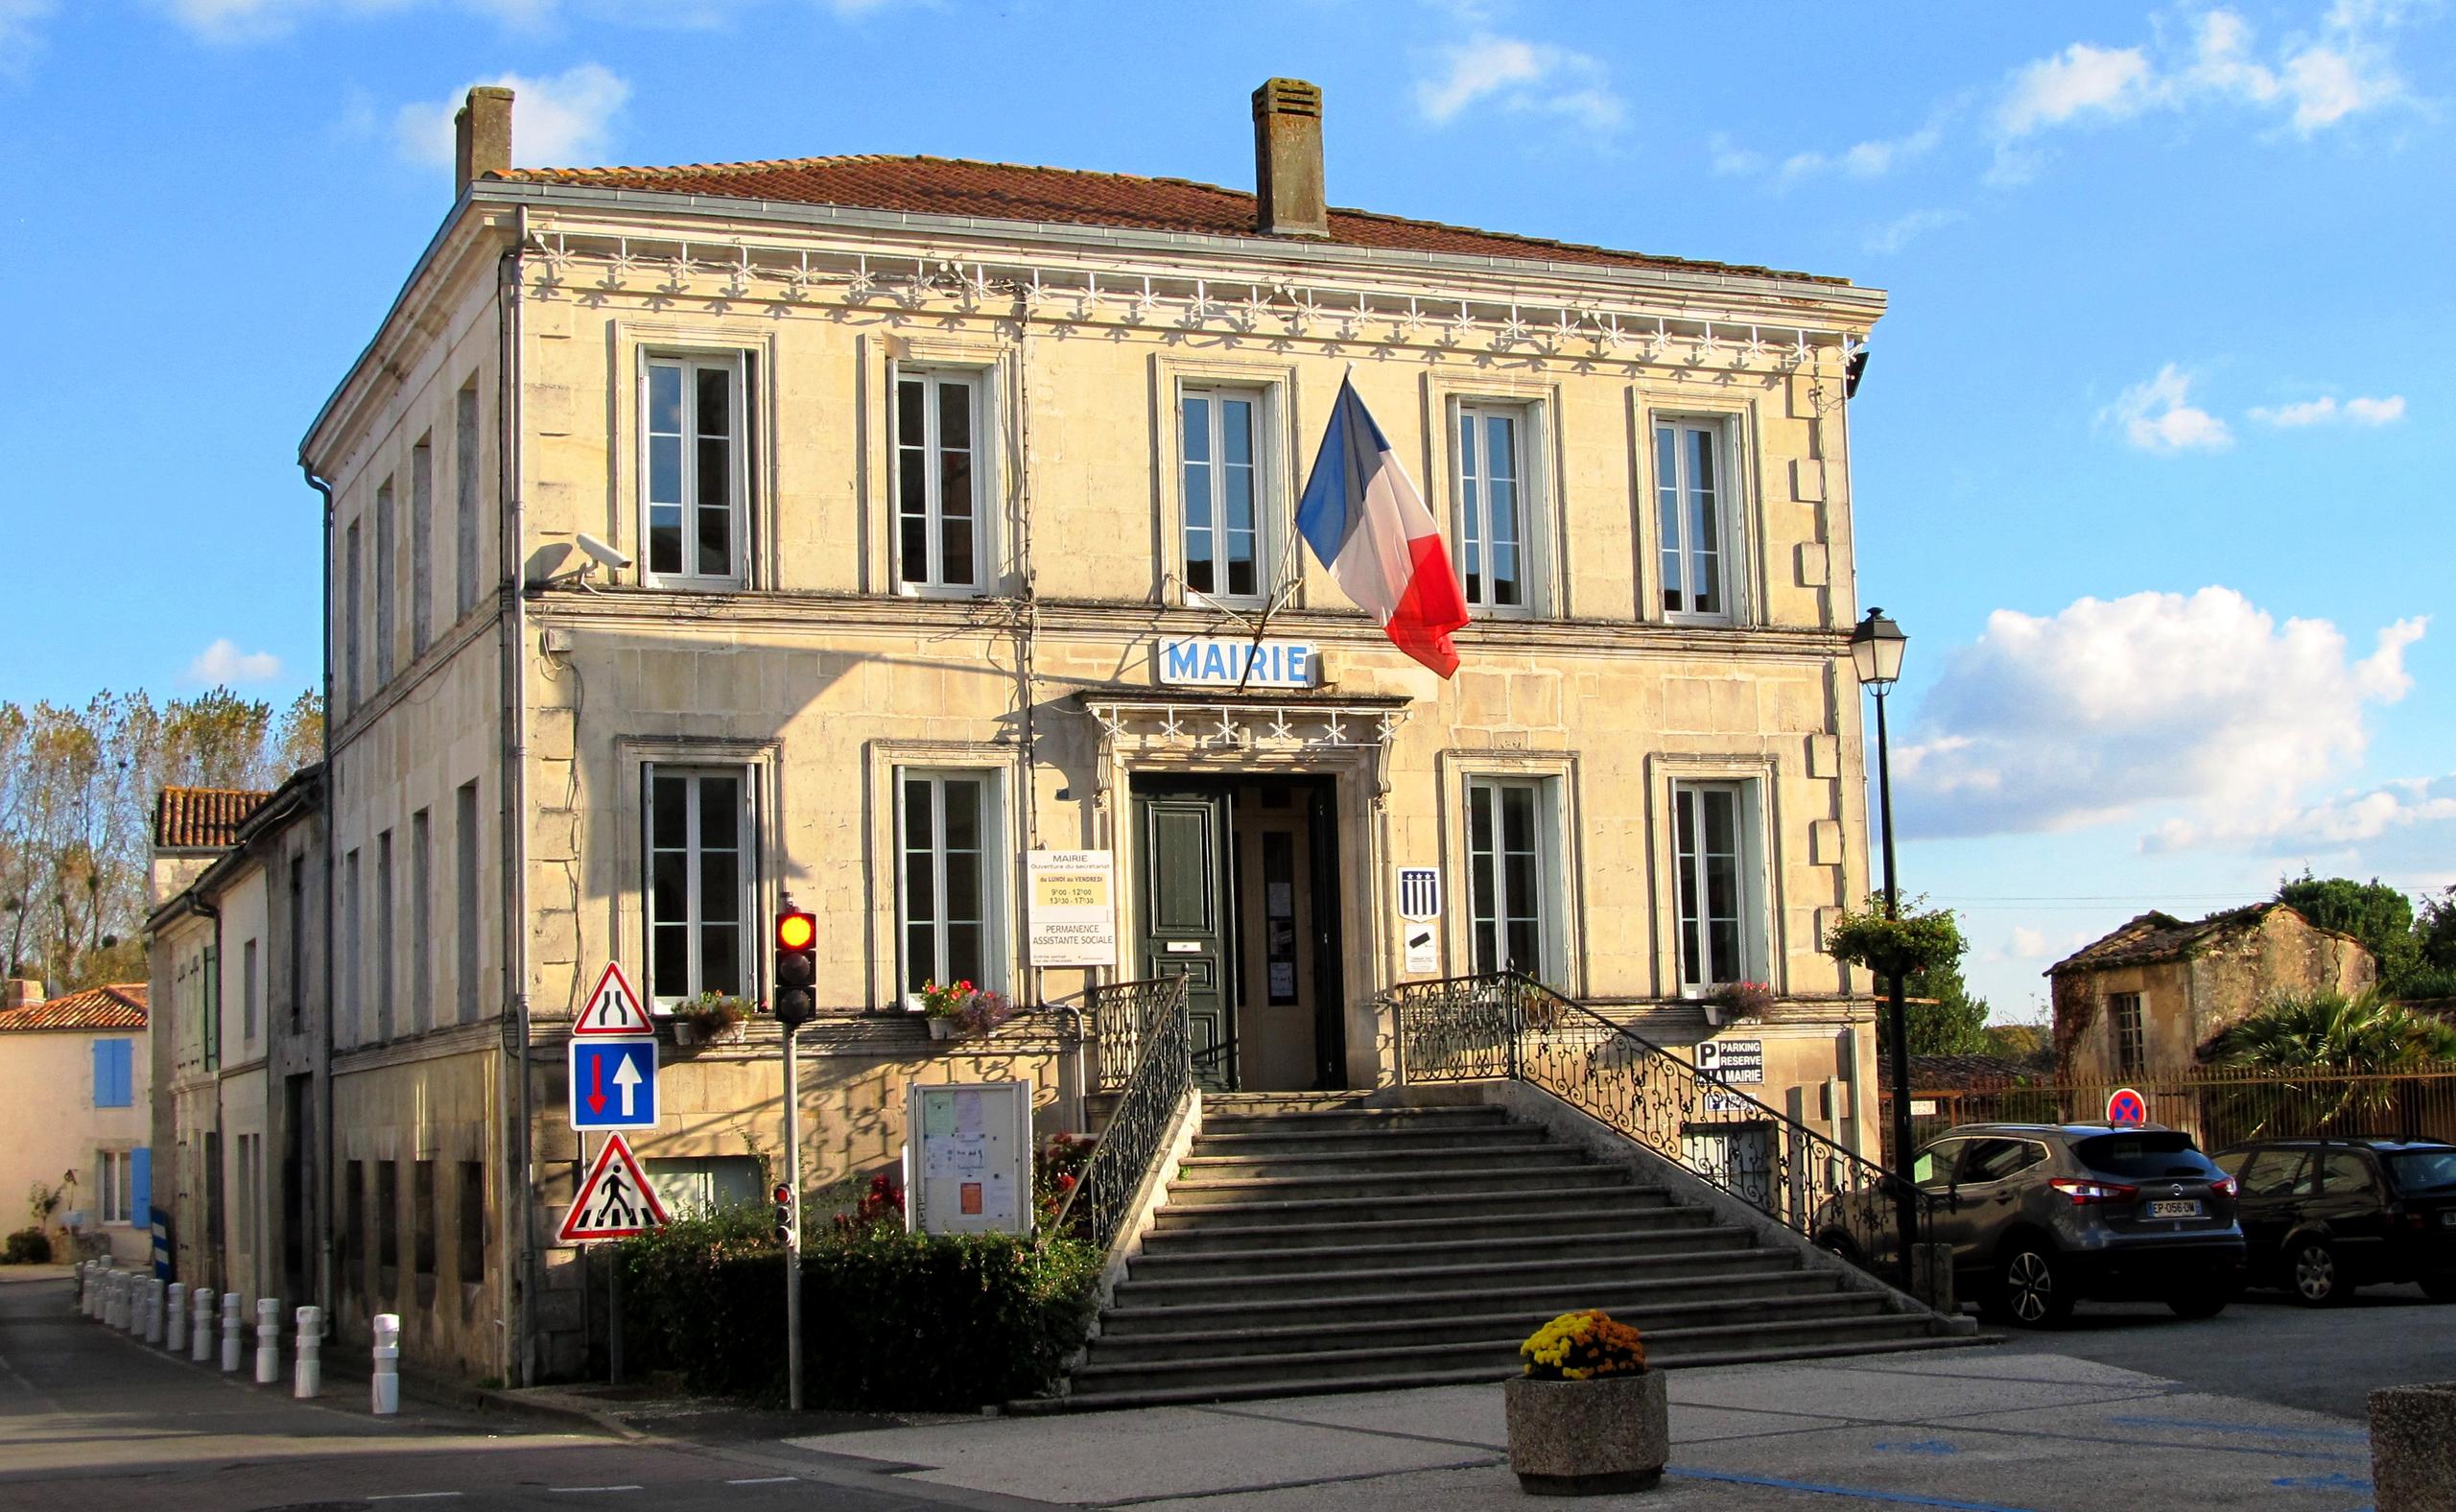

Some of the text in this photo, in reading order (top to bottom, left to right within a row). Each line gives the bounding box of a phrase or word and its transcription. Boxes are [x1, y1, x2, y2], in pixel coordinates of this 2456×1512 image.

[1168, 642, 1308, 683] MAIRIE
[1046, 925, 1099, 933] PERMANENCE
[1032, 935, 1113, 945] ASSISTANTE SOCIALE
[1720, 1042, 1760, 1052] PARKING
[1700, 1043, 1716, 1067] P
[1720, 1055, 1762, 1066] RESERVE
[1725, 1069, 1762, 1083] MAIRIE
